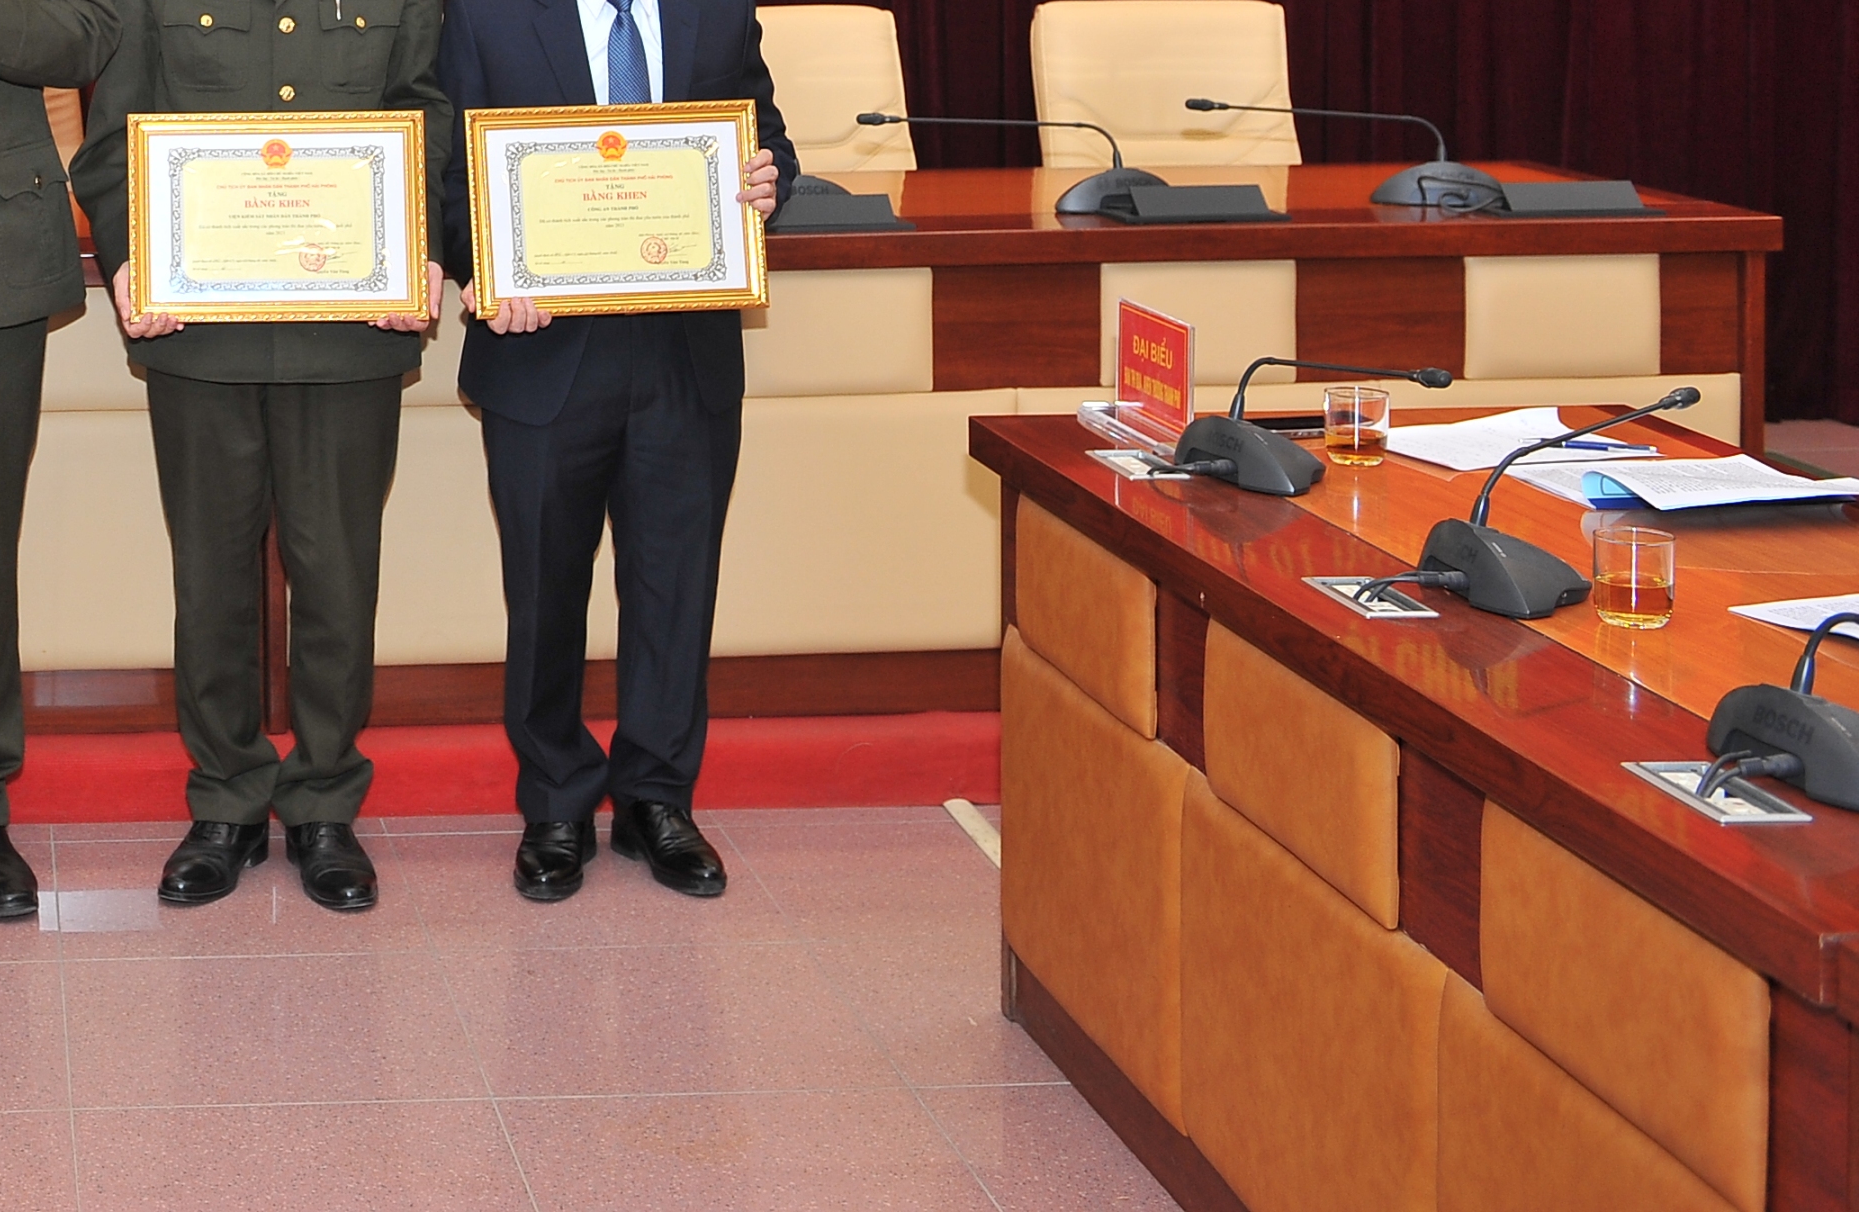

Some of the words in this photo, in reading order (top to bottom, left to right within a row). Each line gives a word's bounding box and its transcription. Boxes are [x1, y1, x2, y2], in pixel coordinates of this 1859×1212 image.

[583, 190, 613, 201] BẰNG
[617, 191, 647, 199] KHEN
[245, 197, 275, 208] BẰNG
[279, 199, 310, 208] KHEN
[1132, 334, 1149, 362] ĐẠI
[1150, 337, 1173, 370] BIỂU
